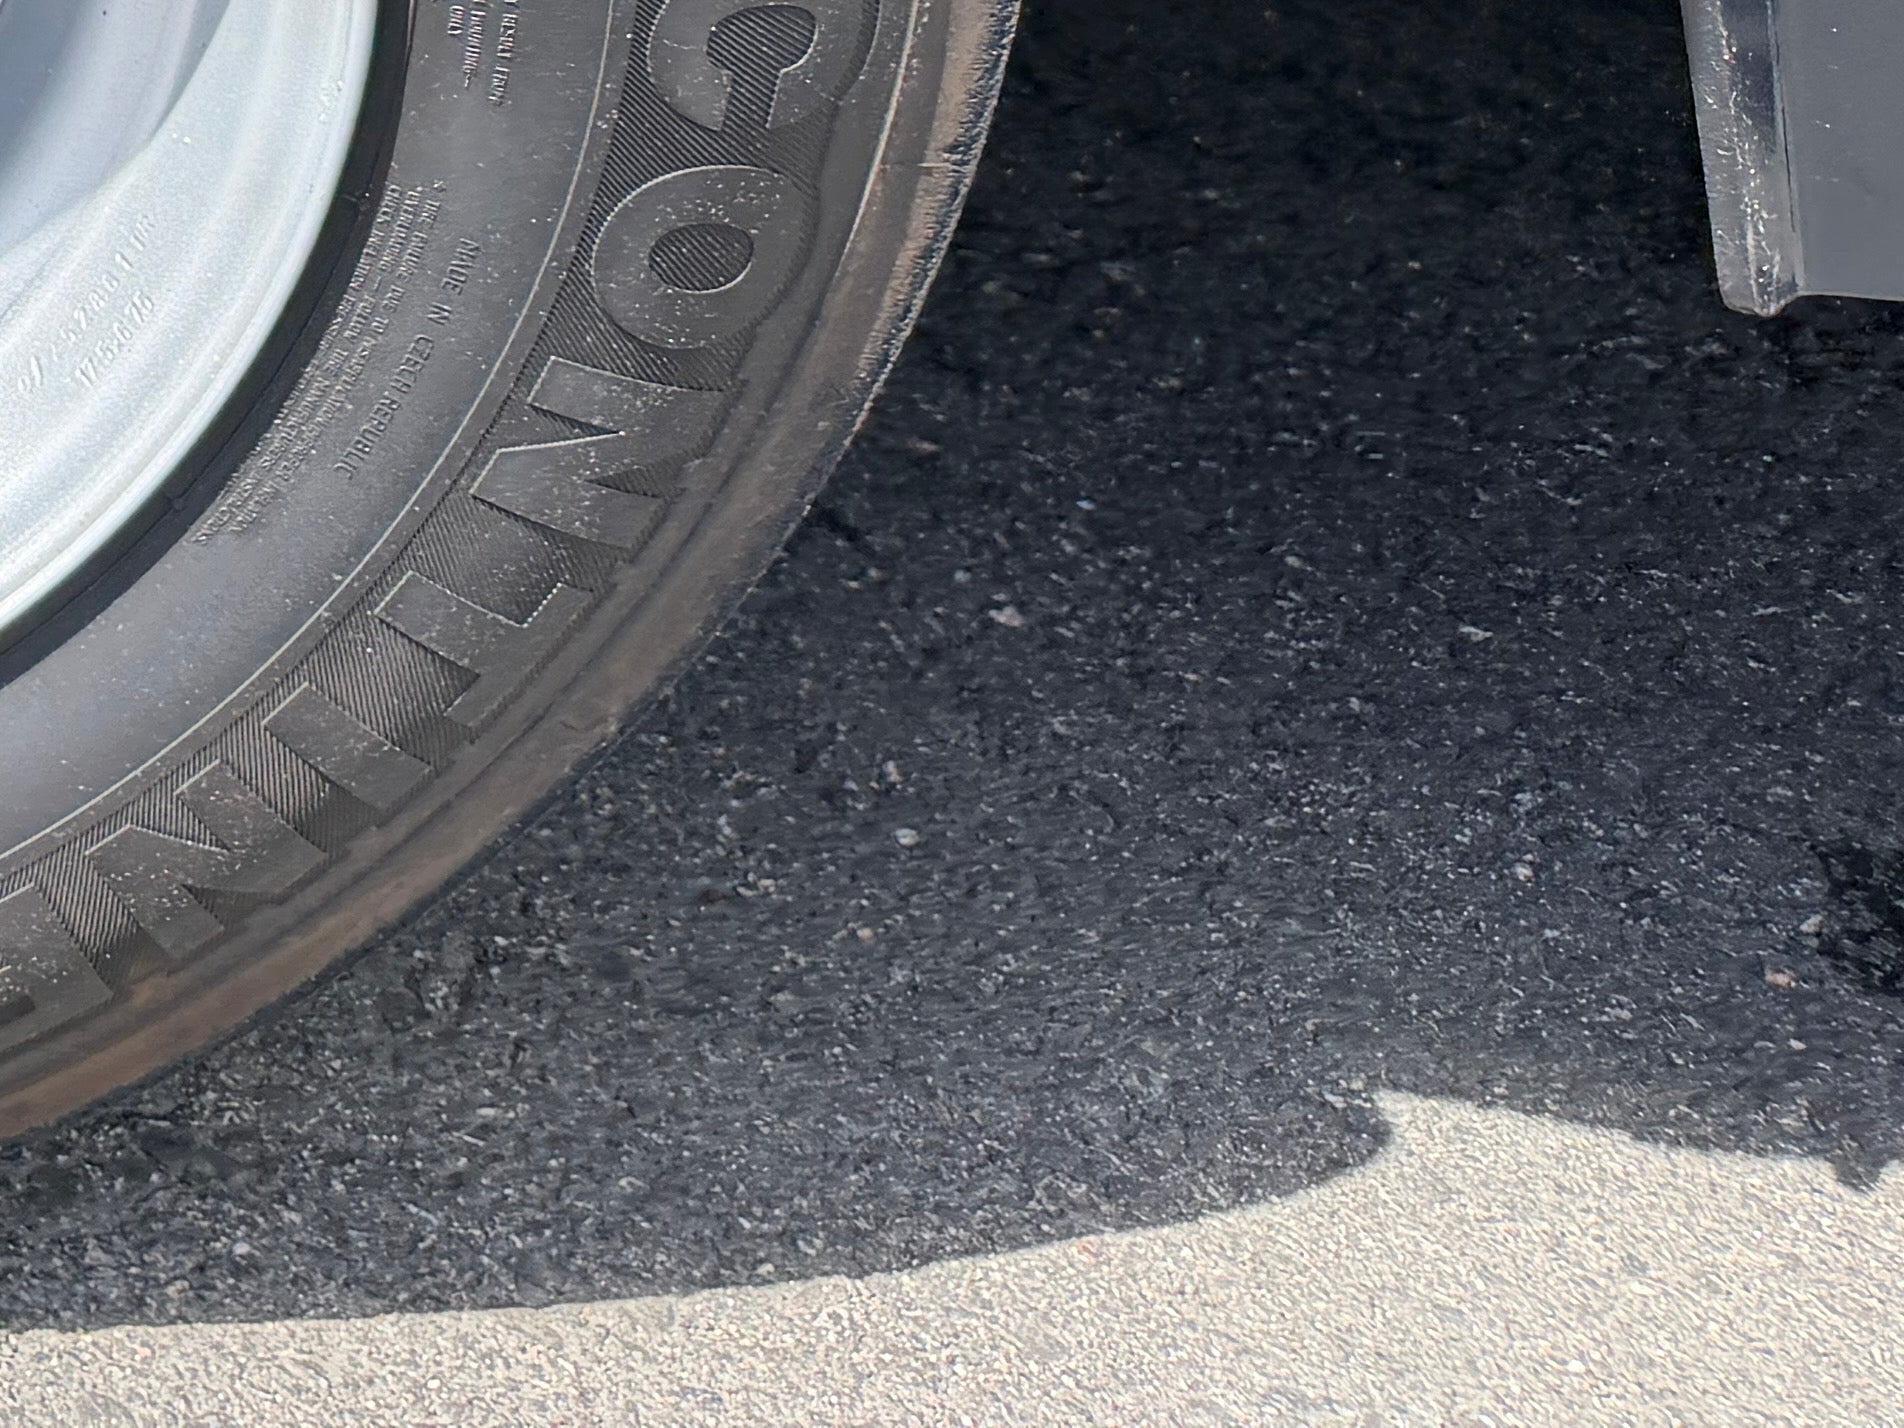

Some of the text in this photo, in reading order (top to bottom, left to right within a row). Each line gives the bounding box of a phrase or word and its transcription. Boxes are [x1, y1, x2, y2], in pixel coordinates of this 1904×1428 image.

[332, 236, 481, 480] MADE IN CZECH REPUBLIC
